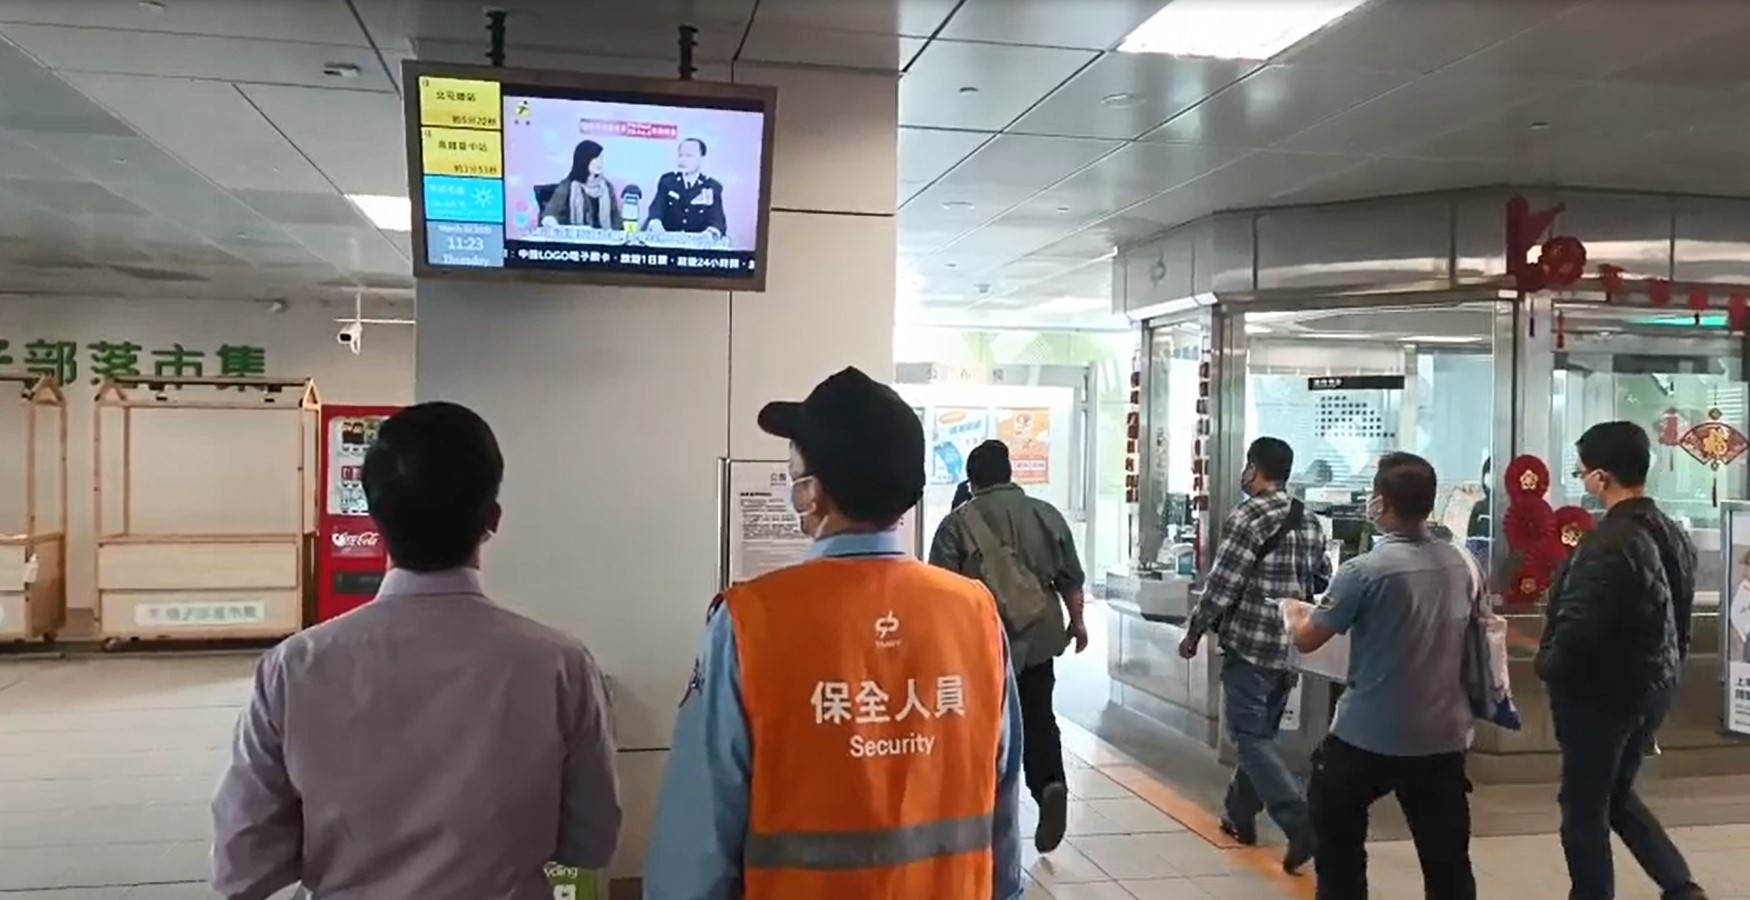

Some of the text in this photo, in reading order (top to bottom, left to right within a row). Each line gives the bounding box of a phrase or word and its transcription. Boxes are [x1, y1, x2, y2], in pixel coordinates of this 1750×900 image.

[448, 236, 484, 251] 11:23
[810, 674, 966, 725] 保全人員
[850, 732, 936, 758] Security
